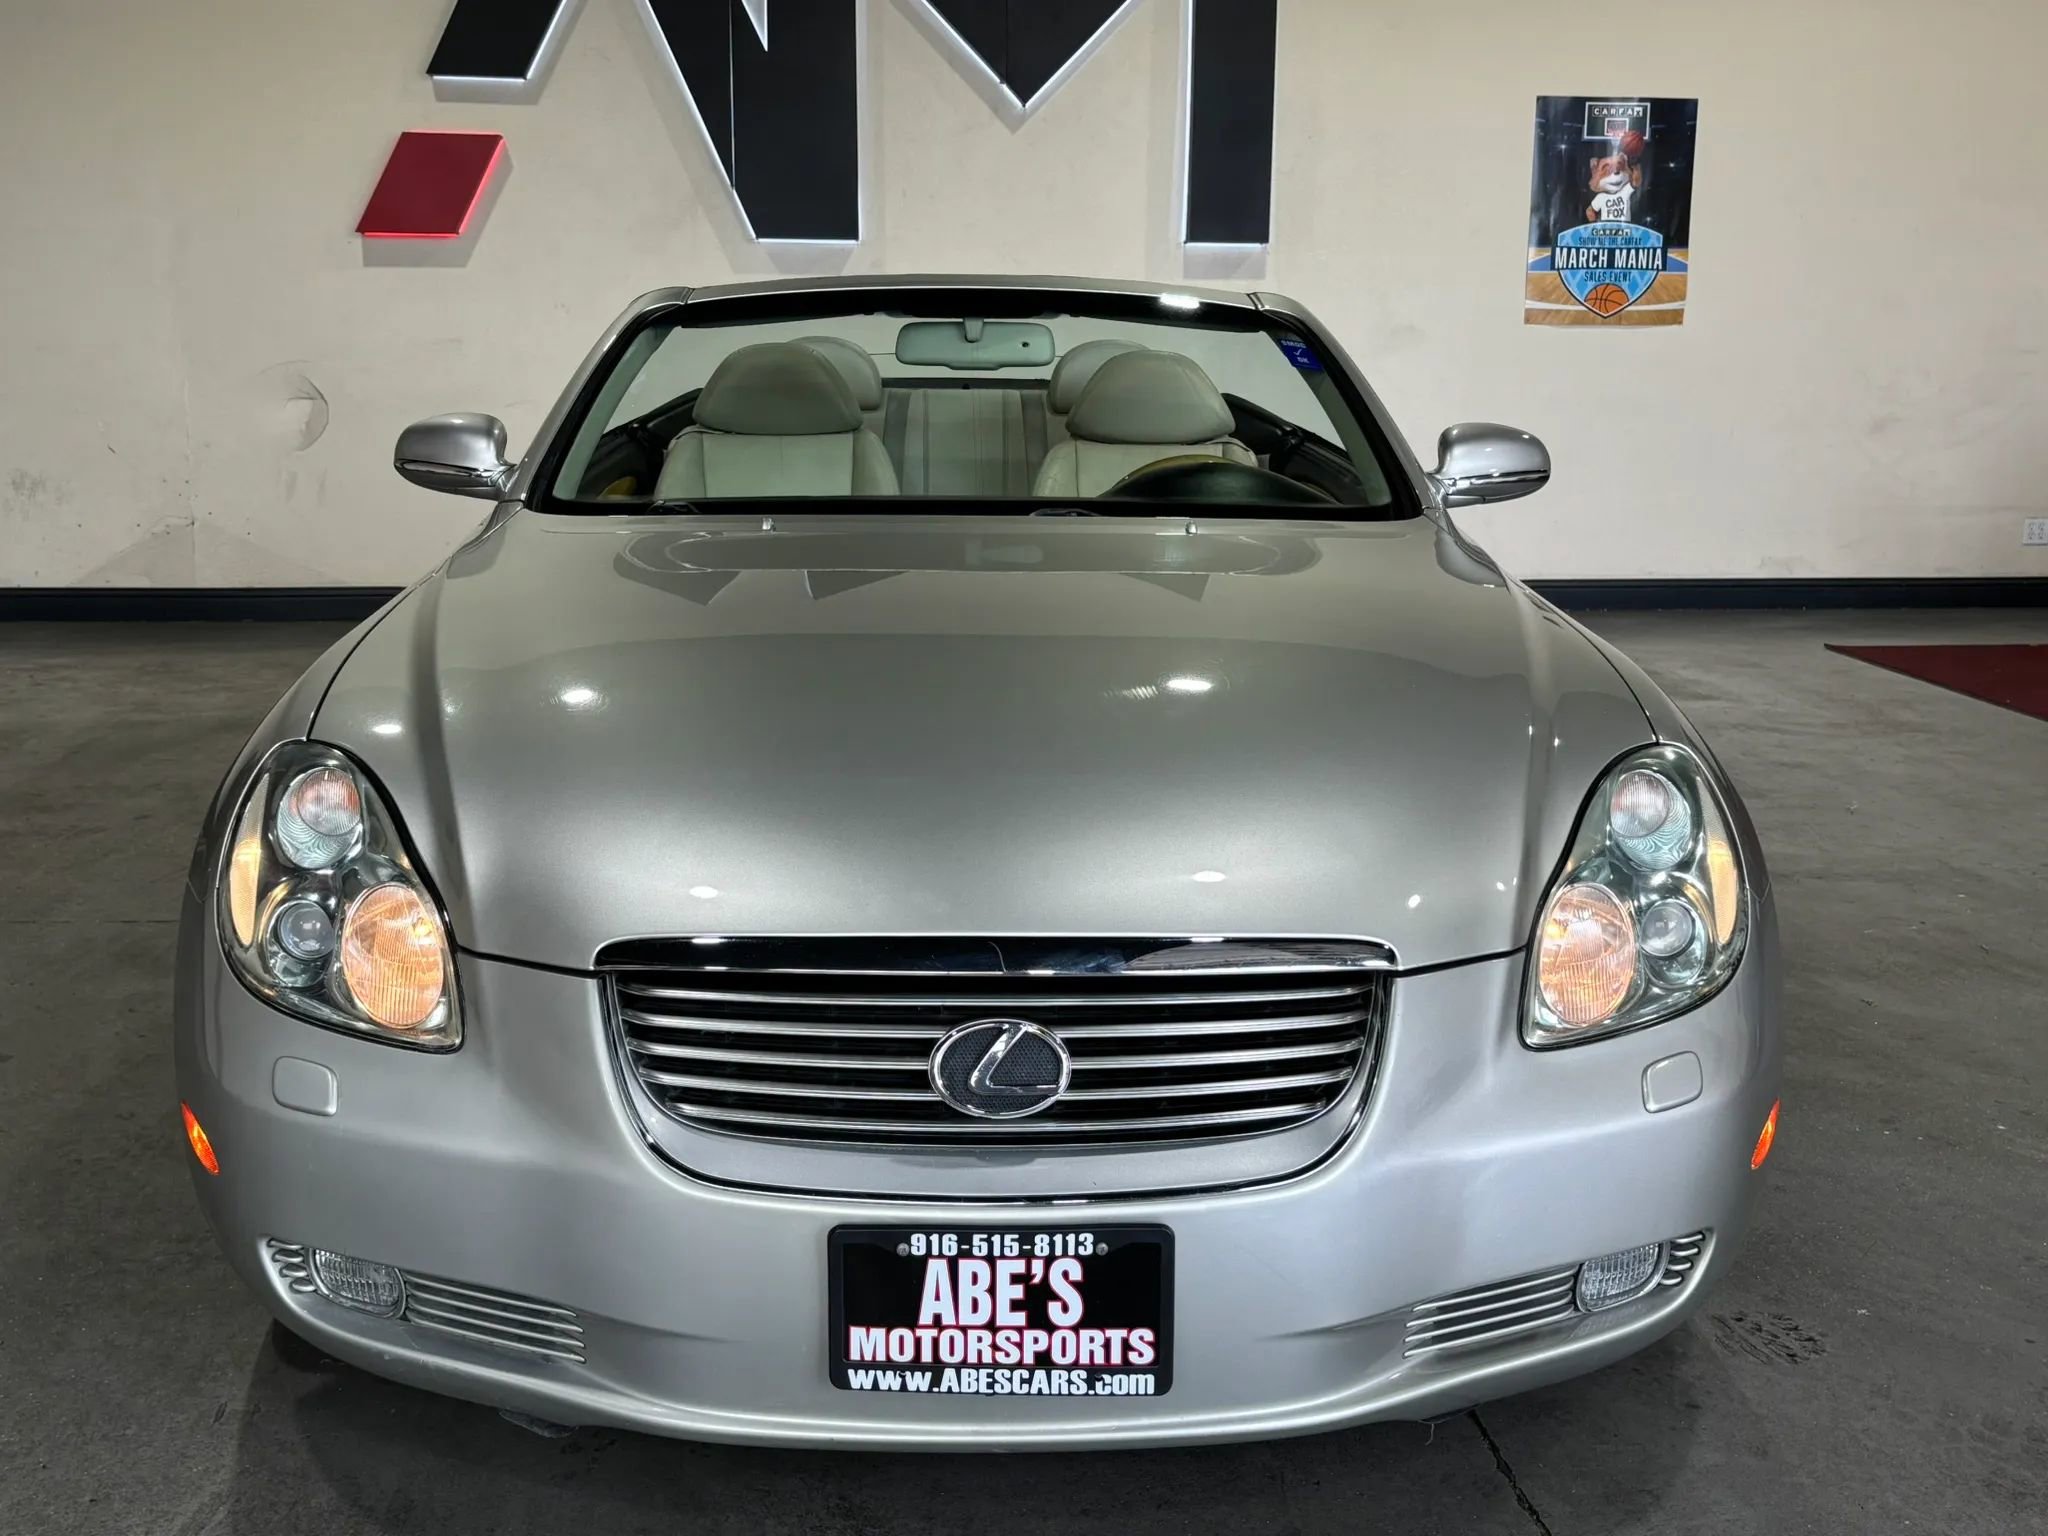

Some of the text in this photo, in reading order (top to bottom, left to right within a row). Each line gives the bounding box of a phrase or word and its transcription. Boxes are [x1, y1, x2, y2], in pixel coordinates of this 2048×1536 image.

[1593, 107, 1643, 117] CARFAX
[1605, 196, 1624, 208] CAR
[1606, 207, 1626, 218] FOX
[1554, 247, 1662, 270] MARCH MANIA
[1584, 271, 1631, 283] SALES EVENT
[910, 1232, 1095, 1257] 916-515-8113
[916, 1256, 1084, 1328] ABE'S
[848, 1325, 1156, 1366] MOTORSPORTS
